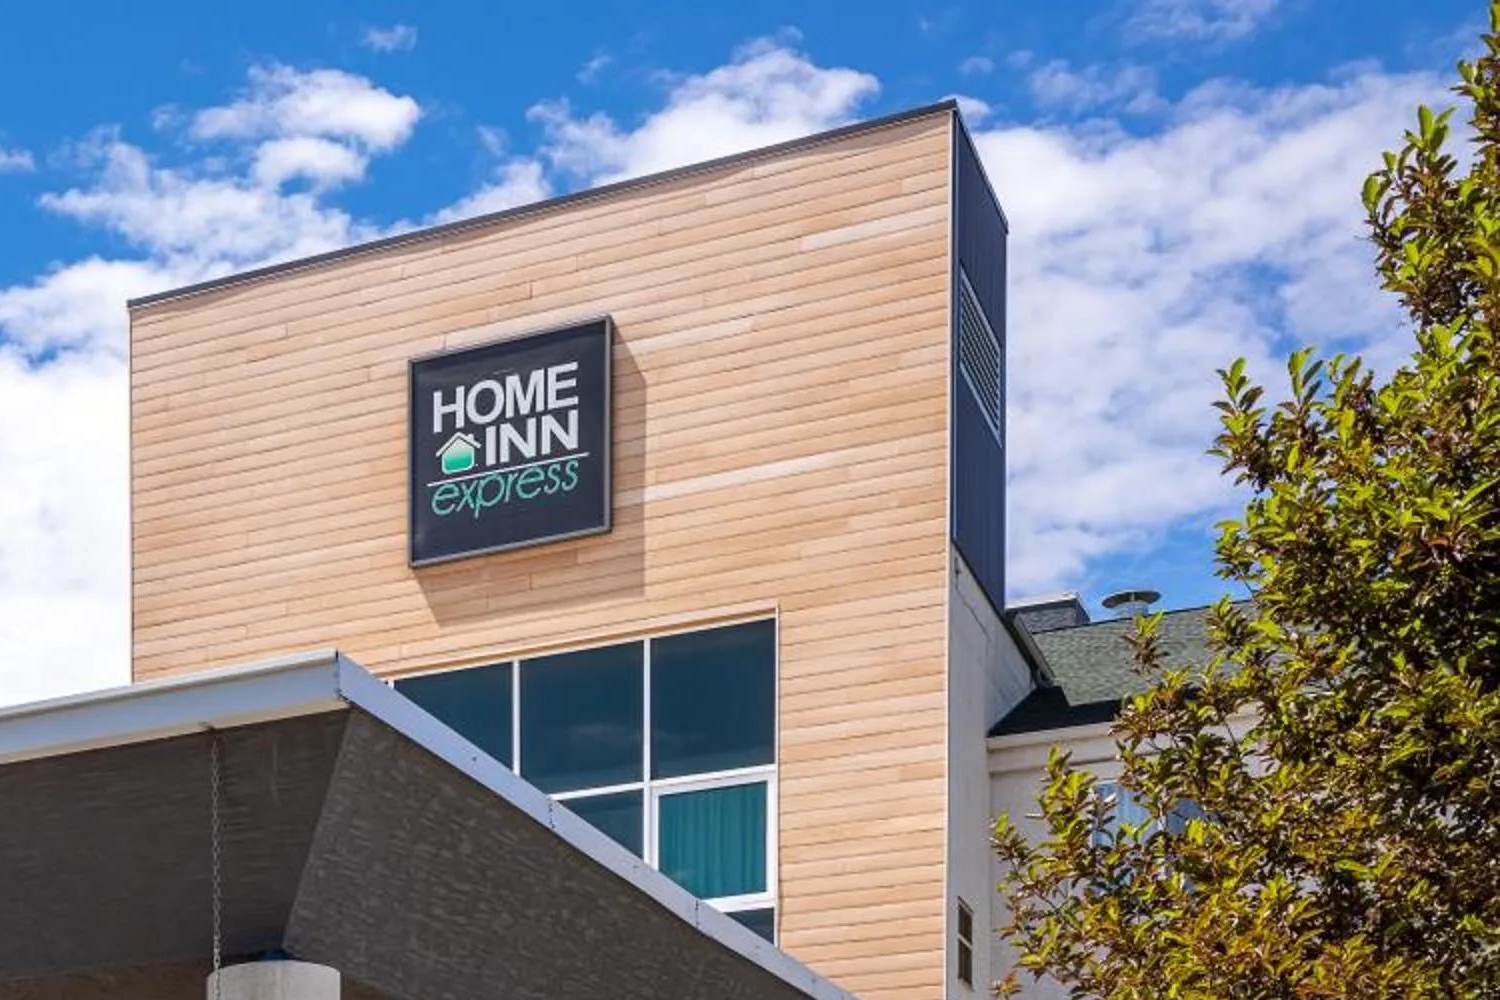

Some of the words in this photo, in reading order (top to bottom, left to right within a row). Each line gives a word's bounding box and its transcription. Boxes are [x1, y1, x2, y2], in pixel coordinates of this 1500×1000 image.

[433, 362, 579, 433] HOME
[485, 409, 579, 466] INN
[431, 459, 579, 518] express
